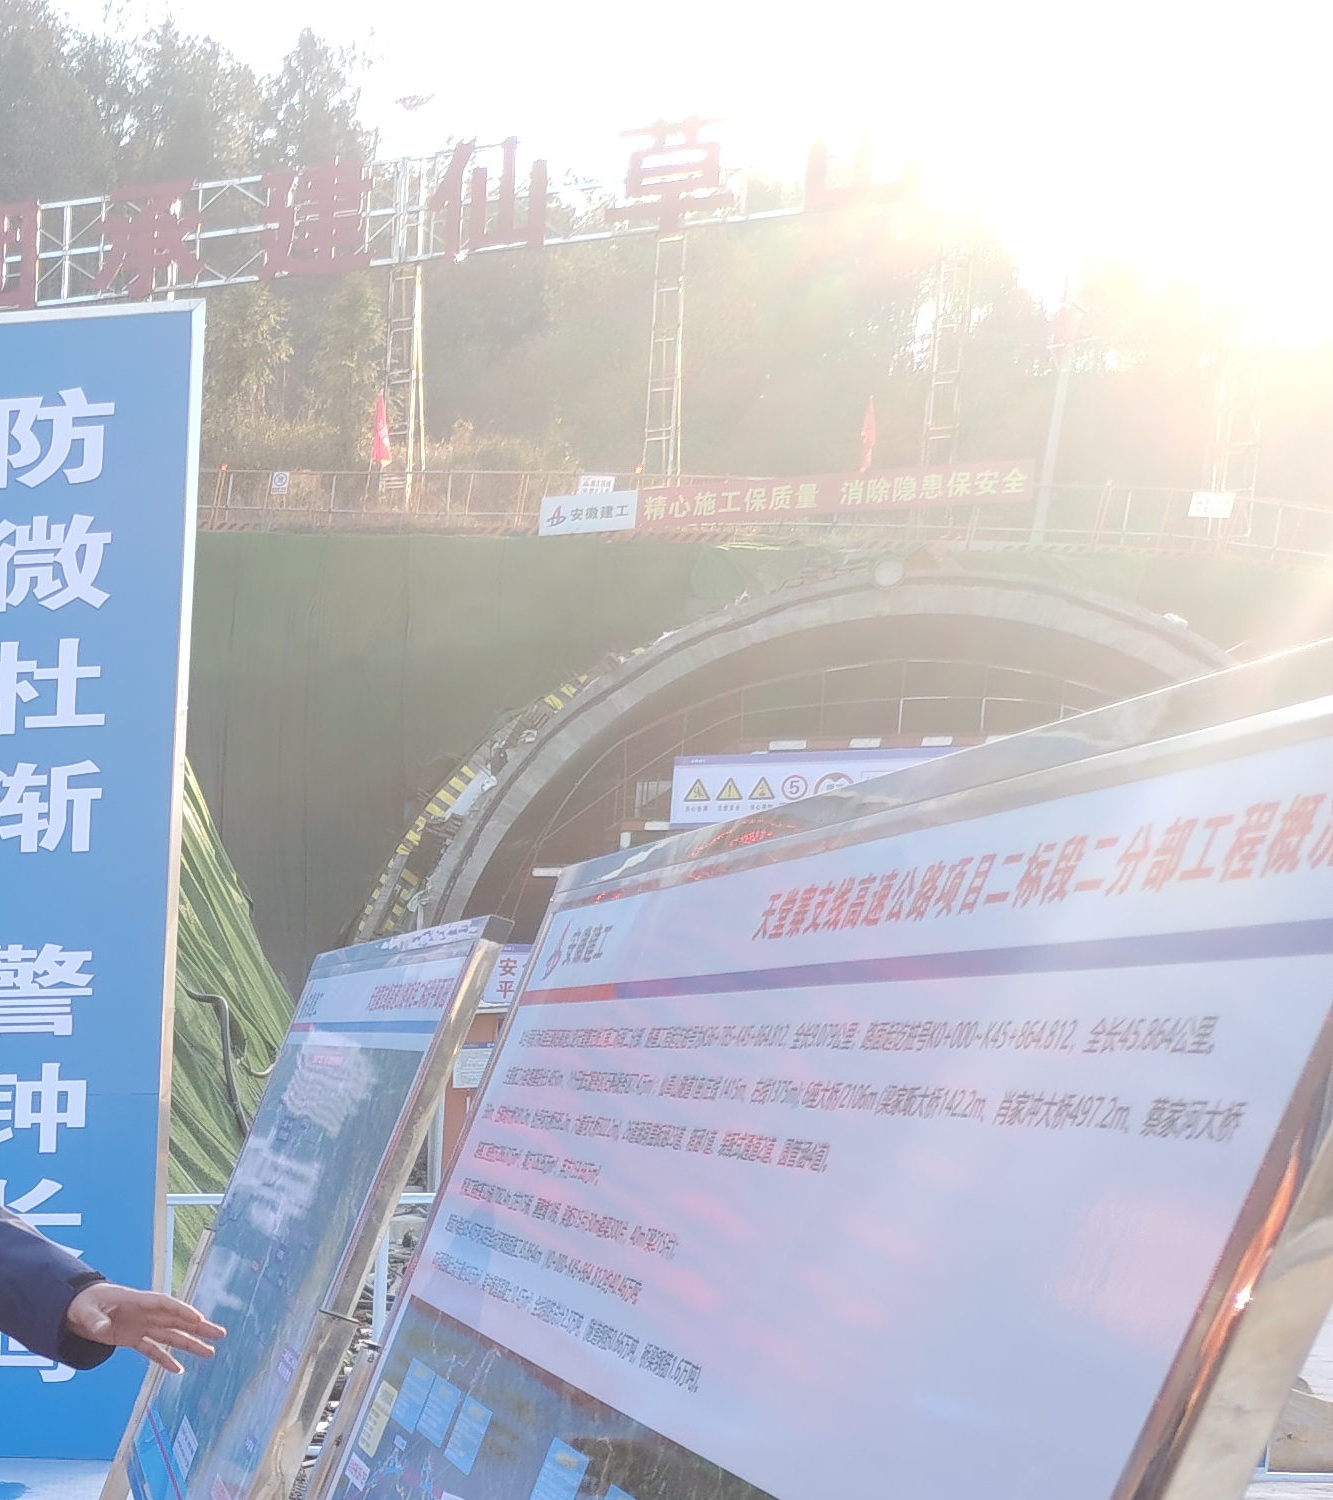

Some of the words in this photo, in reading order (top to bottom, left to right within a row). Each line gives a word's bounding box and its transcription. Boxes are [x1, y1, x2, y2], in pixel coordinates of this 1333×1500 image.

[643, 483, 820, 521] 精心施工保质量
[839, 467, 1028, 506] 消除隐患保安全
[569, 504, 630, 522] 安徽建工
[788, 779, 801, 795] 5
[561, 923, 604, 966] 安徽建工
[499, 957, 517, 976] 安
[496, 980, 515, 999] 平
